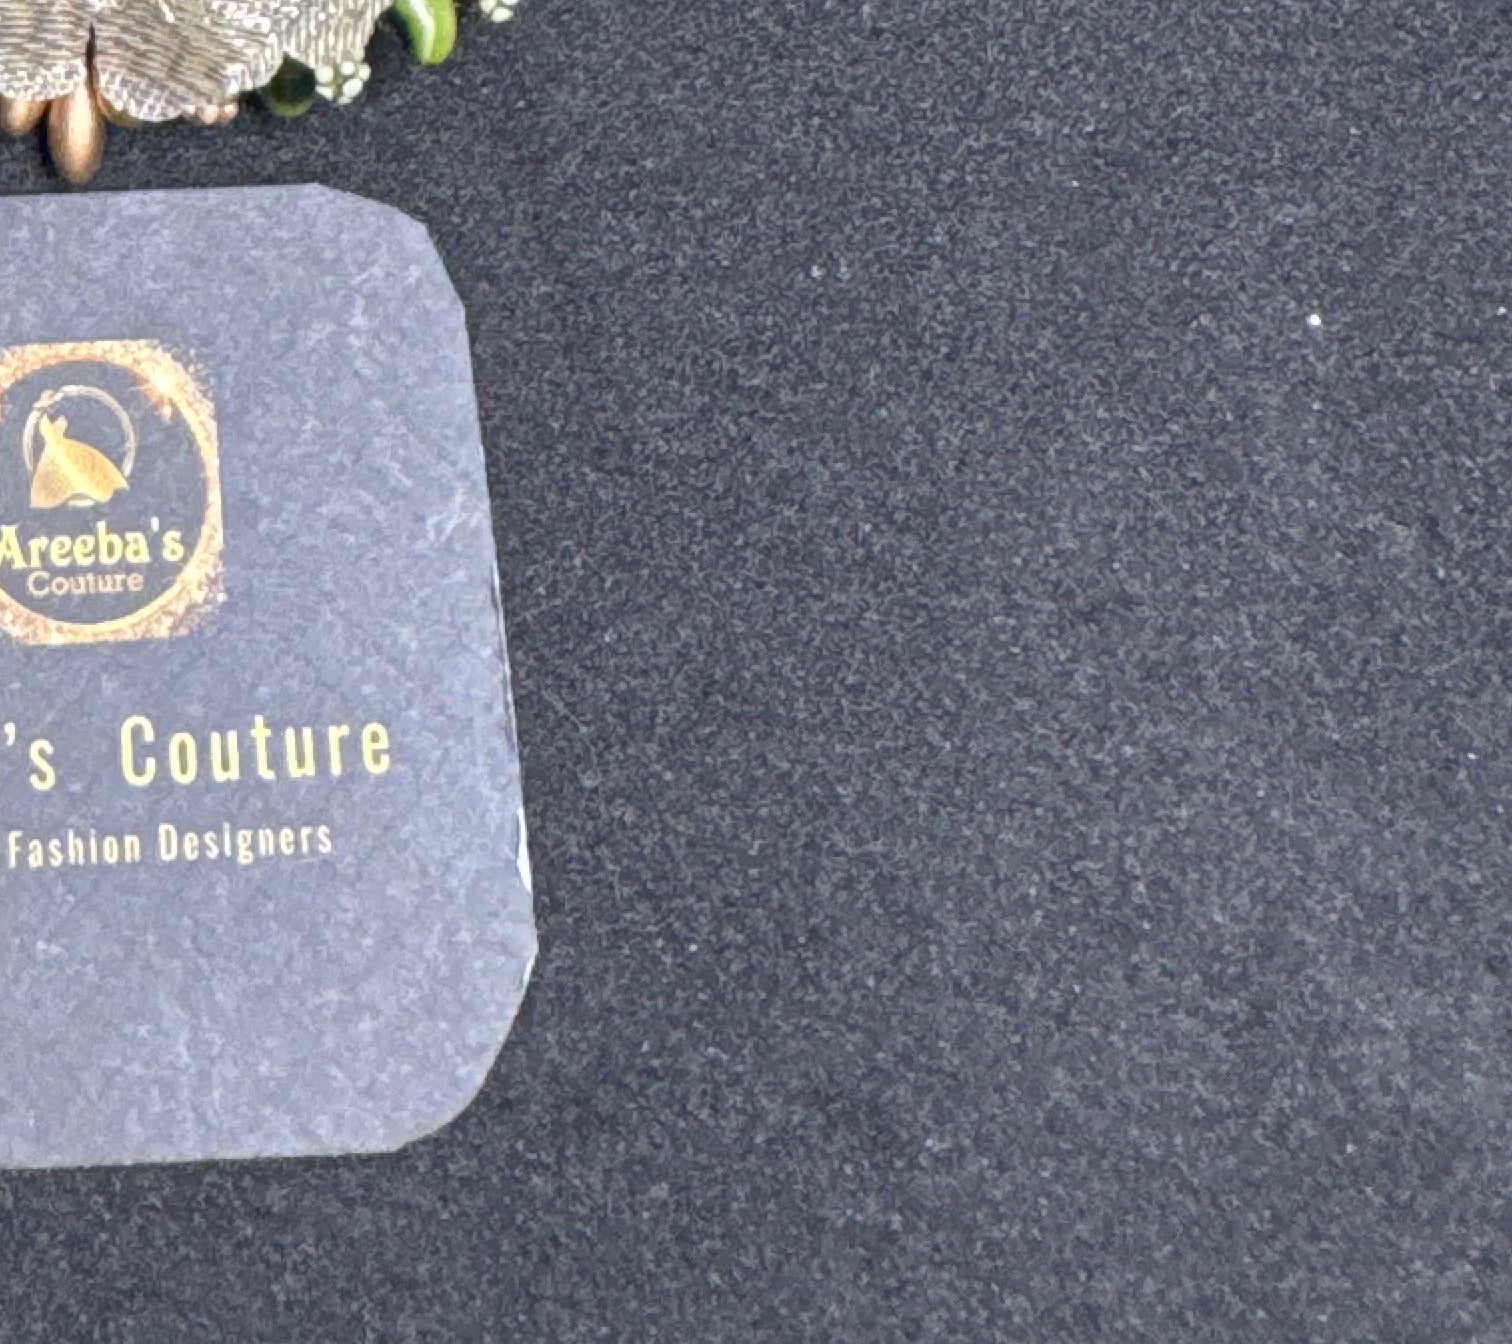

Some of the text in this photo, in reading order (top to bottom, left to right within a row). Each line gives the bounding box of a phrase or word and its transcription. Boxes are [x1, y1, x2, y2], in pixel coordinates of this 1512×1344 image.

[26, 569, 145, 596] Couture
[120, 714, 392, 787] Couture
[7, 828, 143, 871] Fashion
[159, 820, 333, 867] Designers
